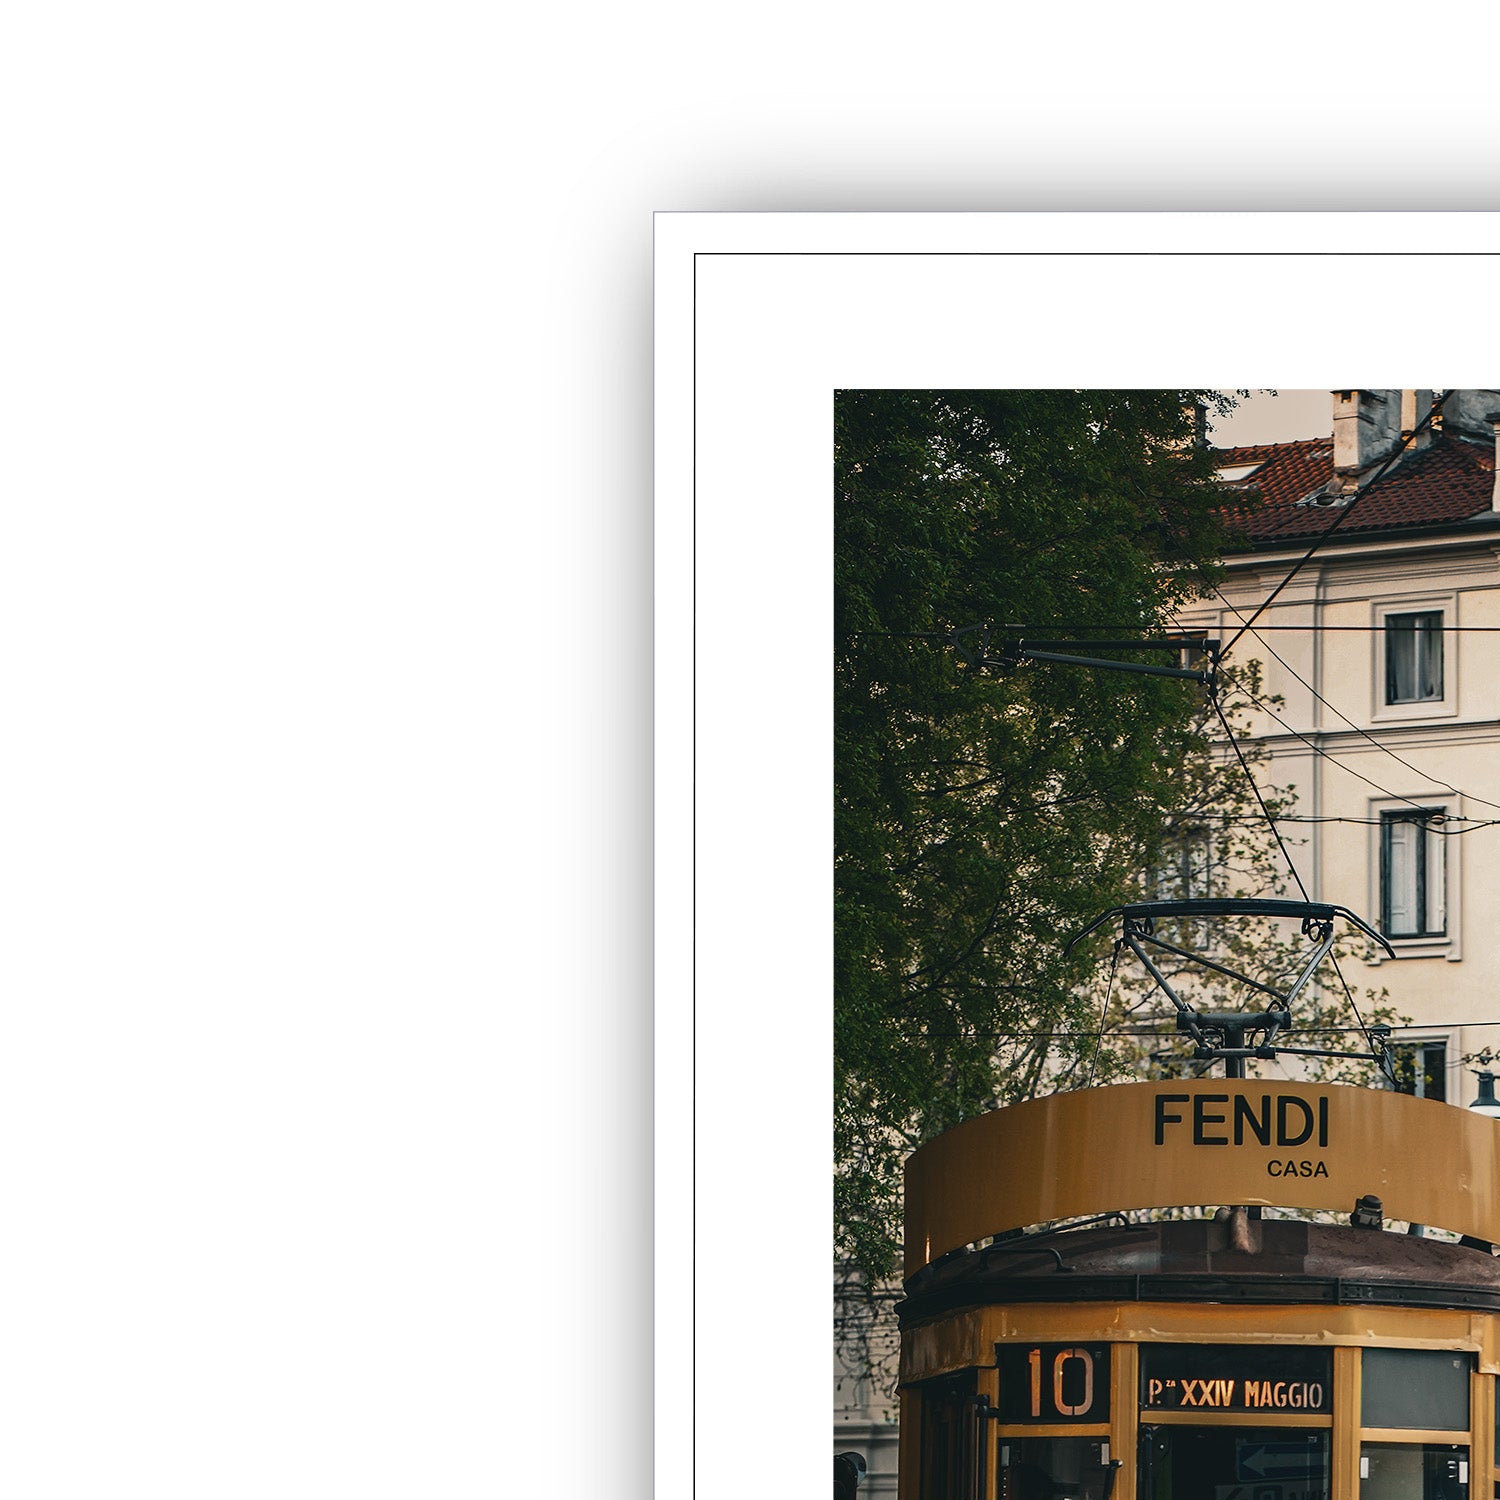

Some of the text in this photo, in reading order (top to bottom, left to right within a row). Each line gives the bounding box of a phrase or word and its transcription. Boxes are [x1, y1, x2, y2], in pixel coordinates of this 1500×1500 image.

[1155, 1094, 1329, 1148] FENDI
[1267, 1160, 1329, 1178] CASA
[1028, 1348, 1094, 1417] 10
[1180, 1379, 1235, 1407] XXIV
[1244, 1380, 1323, 1409] MAGGIO
